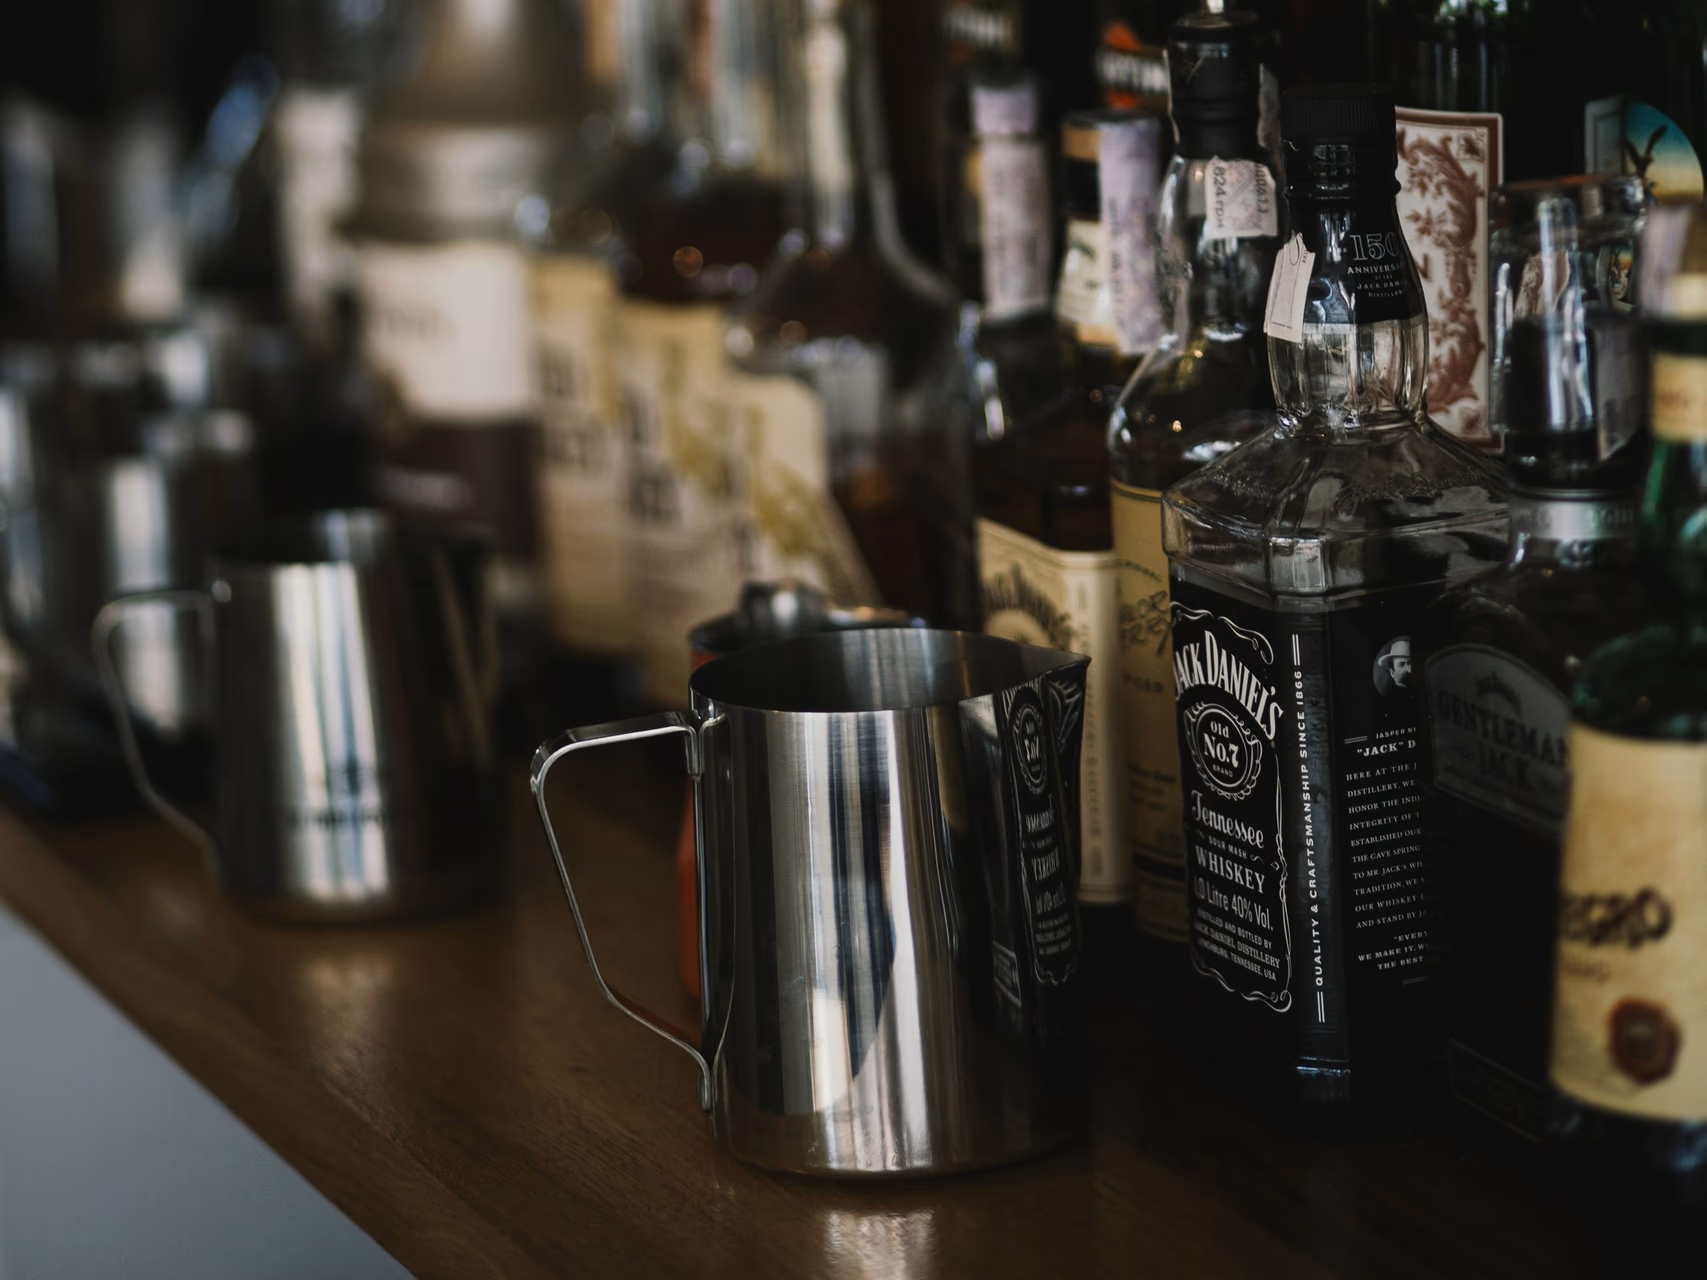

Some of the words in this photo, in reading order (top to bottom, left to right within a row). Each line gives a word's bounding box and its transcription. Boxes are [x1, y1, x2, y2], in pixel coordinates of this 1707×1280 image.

[1349, 231, 1400, 261] 150
[1357, 281, 1381, 291] JACK
[1173, 642, 1206, 701] JACK
[1204, 630, 1284, 740] DANIEL'S
[1294, 670, 1304, 706] 1866
[1210, 720, 1230, 738] Old
[1297, 710, 1308, 759] SINCE
[1376, 728, 1405, 740] JASPER
[1203, 732, 1239, 768] No.7
[1356, 741, 1404, 757] "JACK"
[1212, 764, 1233, 778] BRAND
[1346, 770, 1371, 781] HERE
[1375, 767, 1387, 777] AT
[1391, 763, 1410, 773] THE
[1348, 801, 1379, 814] HONOR
[1381, 798, 1400, 809] THE
[1191, 789, 1264, 848] Tennessee
[1349, 815, 1399, 831] INTEGRITY
[1401, 812, 1413, 822] OF
[1301, 764, 1318, 900] CRAFTSMANSHIP
[1350, 831, 1403, 847] ESTABLISHED
[1404, 827, 1423, 838] OUR
[1208, 835, 1226, 850] SOUR
[1228, 843, 1247, 859] MASH
[1351, 852, 1369, 863] THE
[1370, 849, 1391, 861] CAVE
[1392, 844, 1421, 857] SPRING
[1195, 844, 1265, 894] WHISKEY
[1352, 870, 1365, 880] TO
[1381, 863, 1408, 877] JACK'S
[1405, 877, 1418, 887] WE
[1206, 880, 1229, 912] Litre
[1231, 893, 1253, 923] 40%
[1254, 902, 1274, 931] Vol.
[1310, 903, 1319, 913] &
[1354, 901, 1375, 913] OUR
[1376, 894, 1417, 909] WHISKEY
[1356, 918, 1375, 929] AND
[1376, 912, 1405, 925] STAND
[1406, 910, 1417, 920] BY
[1224, 921, 1236, 934] AND
[1237, 926, 1262, 946] BOTTLED
[1263, 939, 1272, 950] BY
[1209, 927, 1236, 949] DANIEL
[1237, 940, 1280, 969] DISTILLERY
[1311, 918, 1323, 987] QUALITY
[1357, 951, 1372, 962] WE
[1374, 946, 1401, 959] MAKE
[1377, 959, 1397, 970] THE
[1399, 954, 1424, 966] BEST
[1263, 968, 1276, 982] USA
